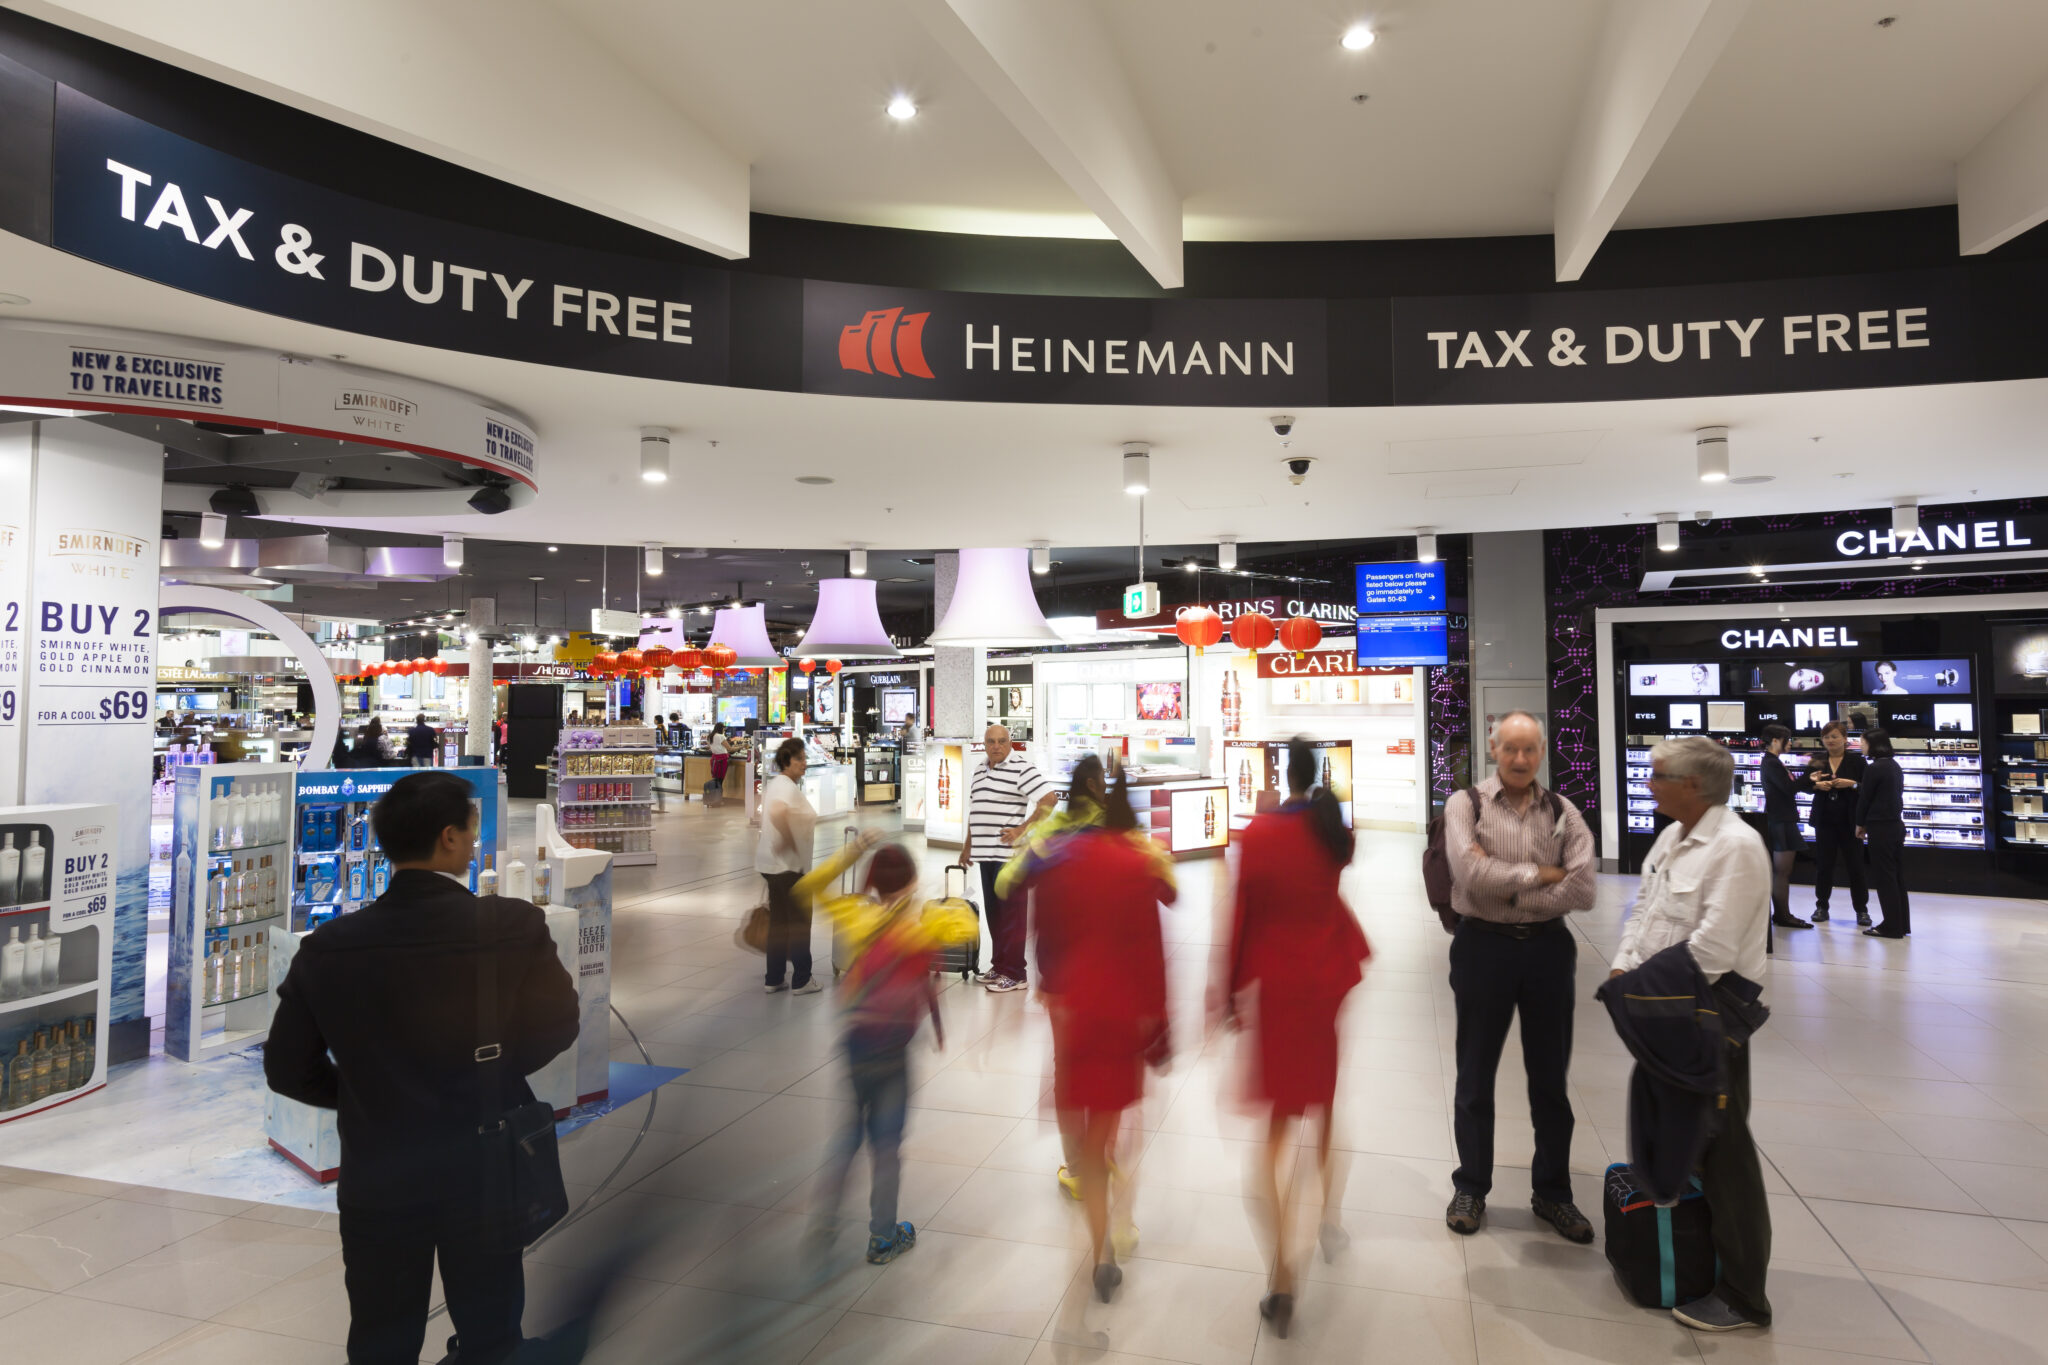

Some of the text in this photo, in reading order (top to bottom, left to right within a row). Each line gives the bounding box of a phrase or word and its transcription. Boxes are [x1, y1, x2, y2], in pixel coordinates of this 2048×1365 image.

[106, 158, 692, 345] TAX & DUTY FREE
[1427, 306, 1930, 370] TAX & DUTY FREE
[965, 324, 1295, 376] HEINEMANN
[72, 351, 222, 383] NEW & EXCLUSIVE
[70, 372, 223, 404] TO TRAVELLERS
[343, 393, 411, 416] SMIRNOFF
[353, 416, 403, 433] WHITE
[486, 422, 534, 456] NEW & EXCLUSIVE
[486, 439, 534, 474] TO TRAVELLERS
[59, 534, 142, 558] SMIRNOFF
[1836, 520, 2031, 557] CHANEL
[72, 562, 131, 580] WHITE
[1366, 573, 1404, 581] Passengers
[1415, 572, 1435, 580] flights
[1376, 588, 1415, 596] immediately
[1405, 580, 1427, 588] please
[5, 601, 19, 632] 2
[41, 601, 150, 637] BUY 2
[1287, 600, 1359, 622] CLARINS
[40, 640, 150, 654] SMIRNOFF WHITE,
[1721, 627, 1858, 649] CHANEL
[40, 652, 150, 664] GOLD APPLE OR
[1270, 653, 1396, 674] CLARI
[39, 663, 150, 675] GOLD CINNAMON
[870, 675, 901, 684] GUERLAIN
[38, 690, 148, 722] FOR A COOL $69
[1892, 713, 1917, 721] FACE
[298, 783, 393, 796] BOMBAY SAPPHIR
[1271, 775, 1277, 784] 2
[65, 853, 108, 875] BUY 2
[87, 895, 107, 914] $69
[579, 925, 605, 938] REEZE
[579, 934, 605, 946] LTERED
